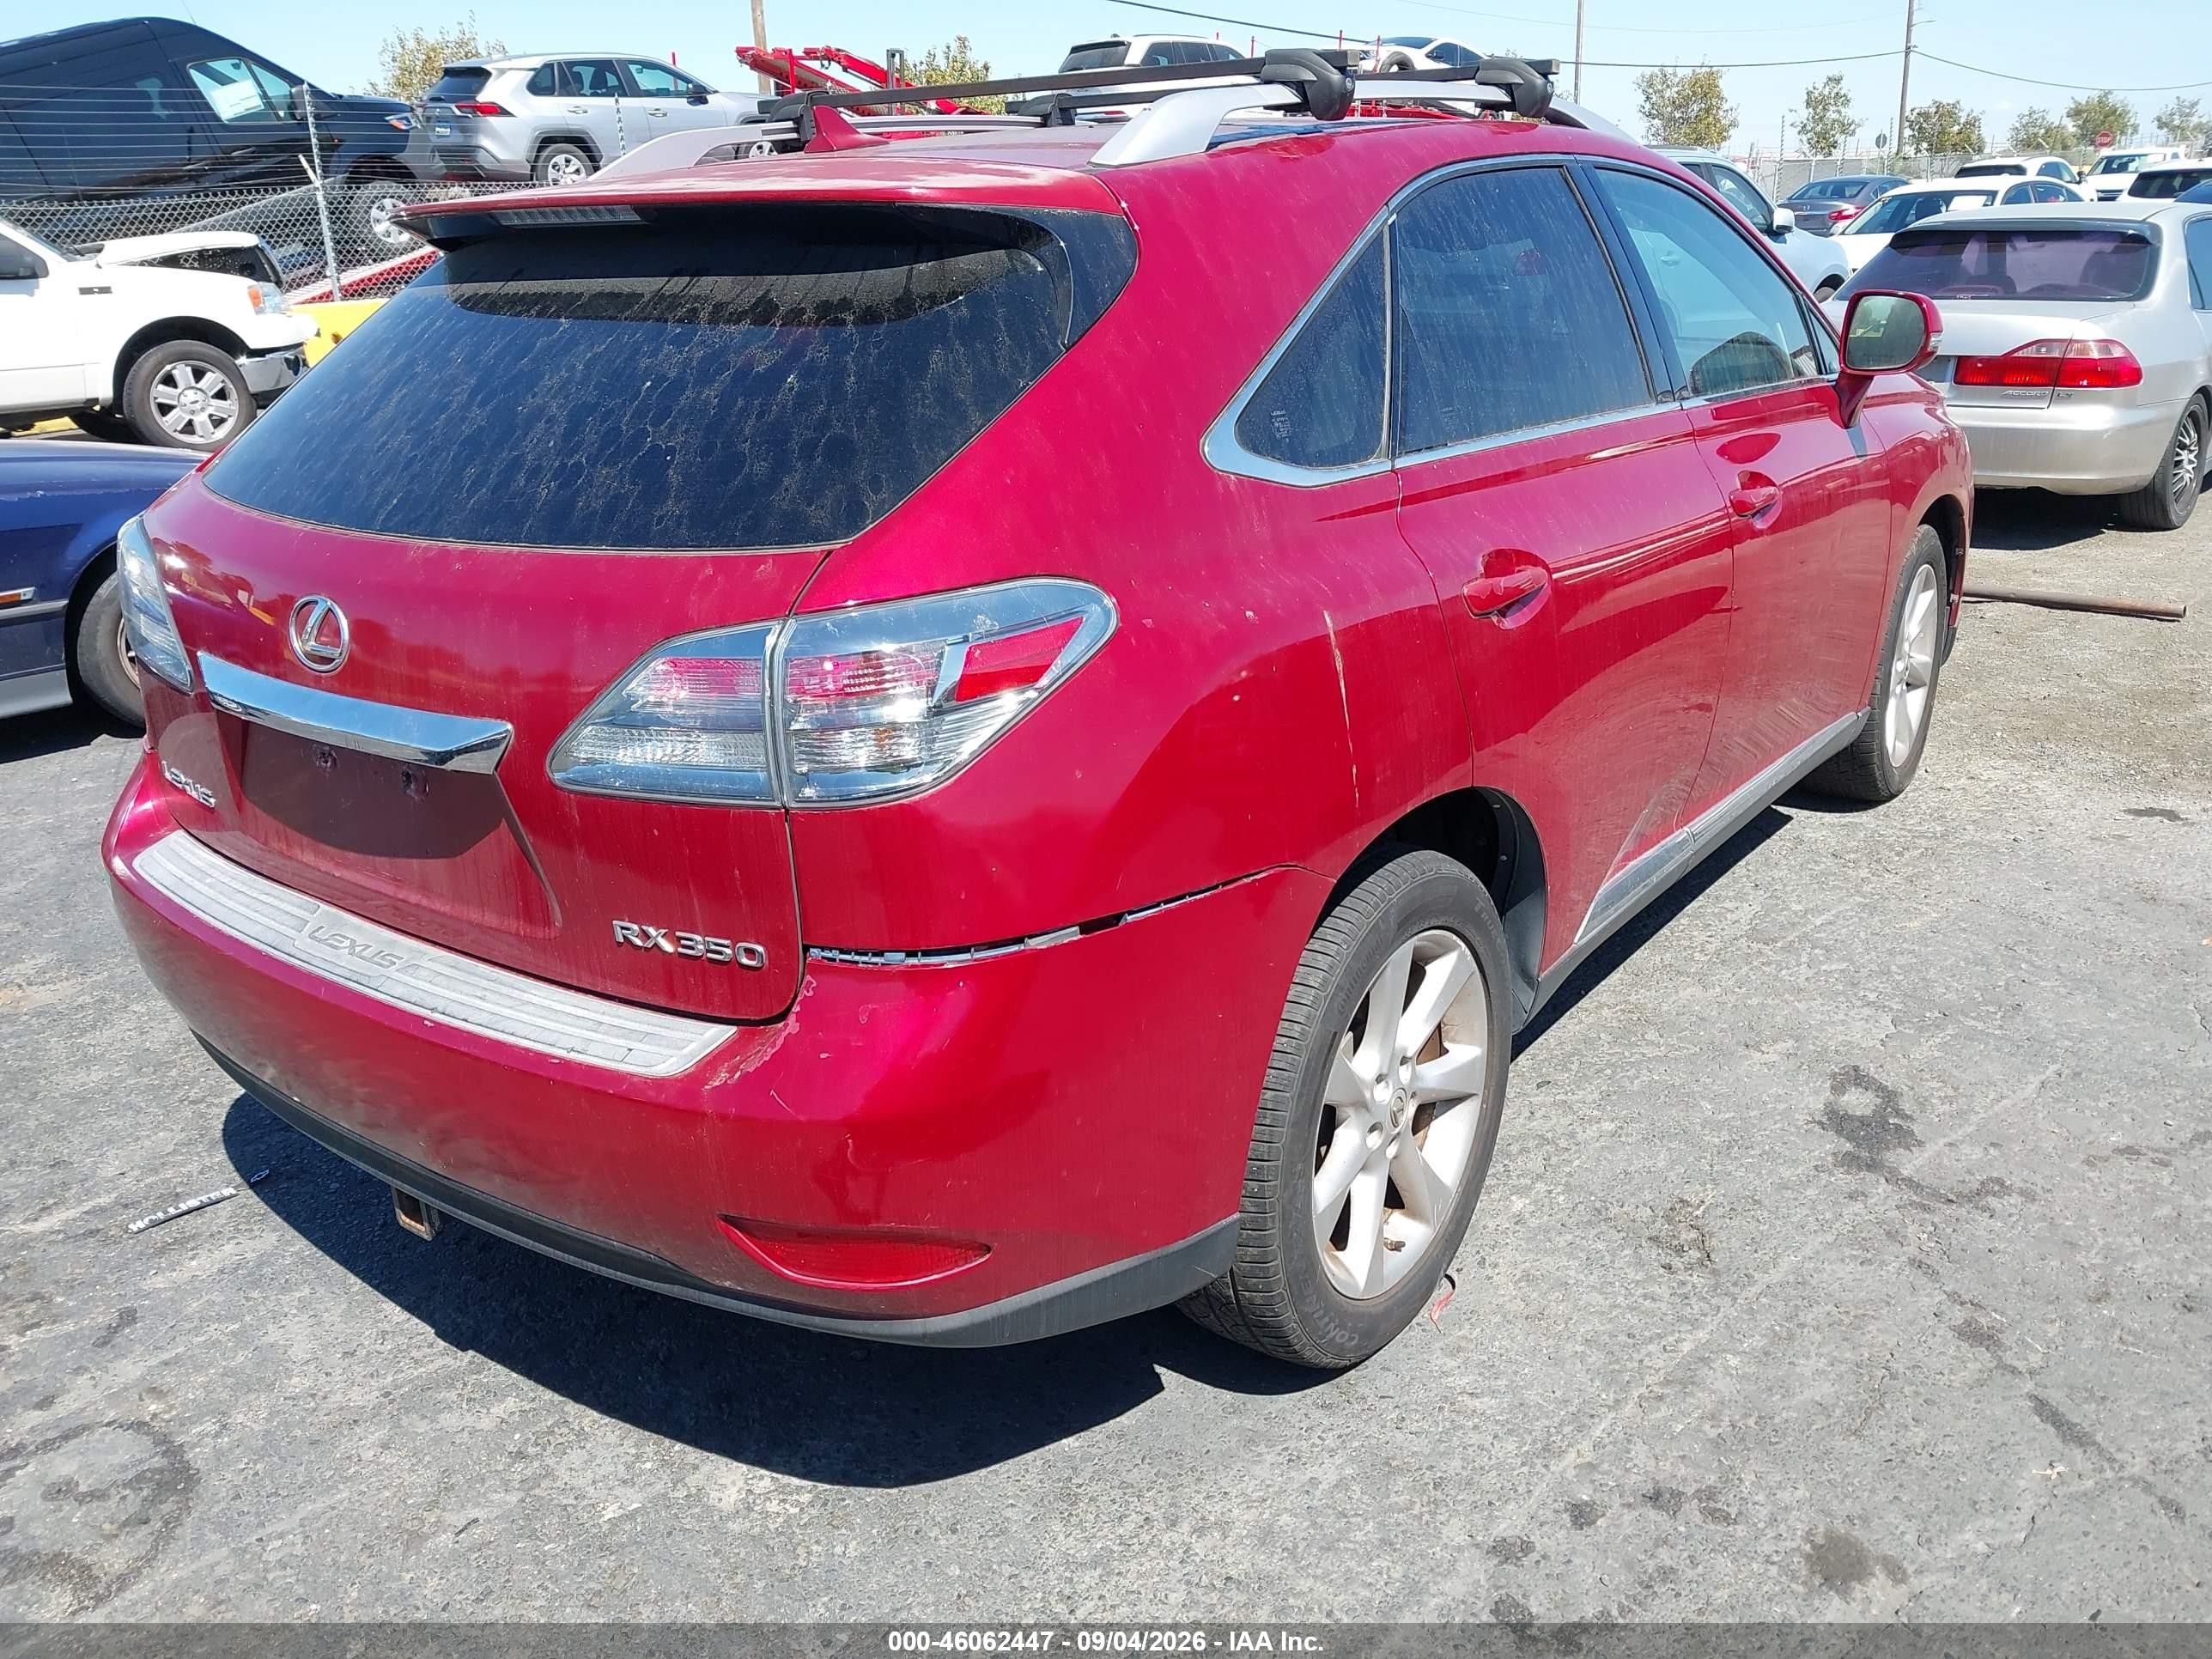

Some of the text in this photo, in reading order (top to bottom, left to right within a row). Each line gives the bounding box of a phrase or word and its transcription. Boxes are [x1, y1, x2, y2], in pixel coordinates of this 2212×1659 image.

[161, 759, 216, 808] LEXUS
[308, 925, 405, 969] LEXUS
[127, 1187, 238, 1233] HOLLISTER
